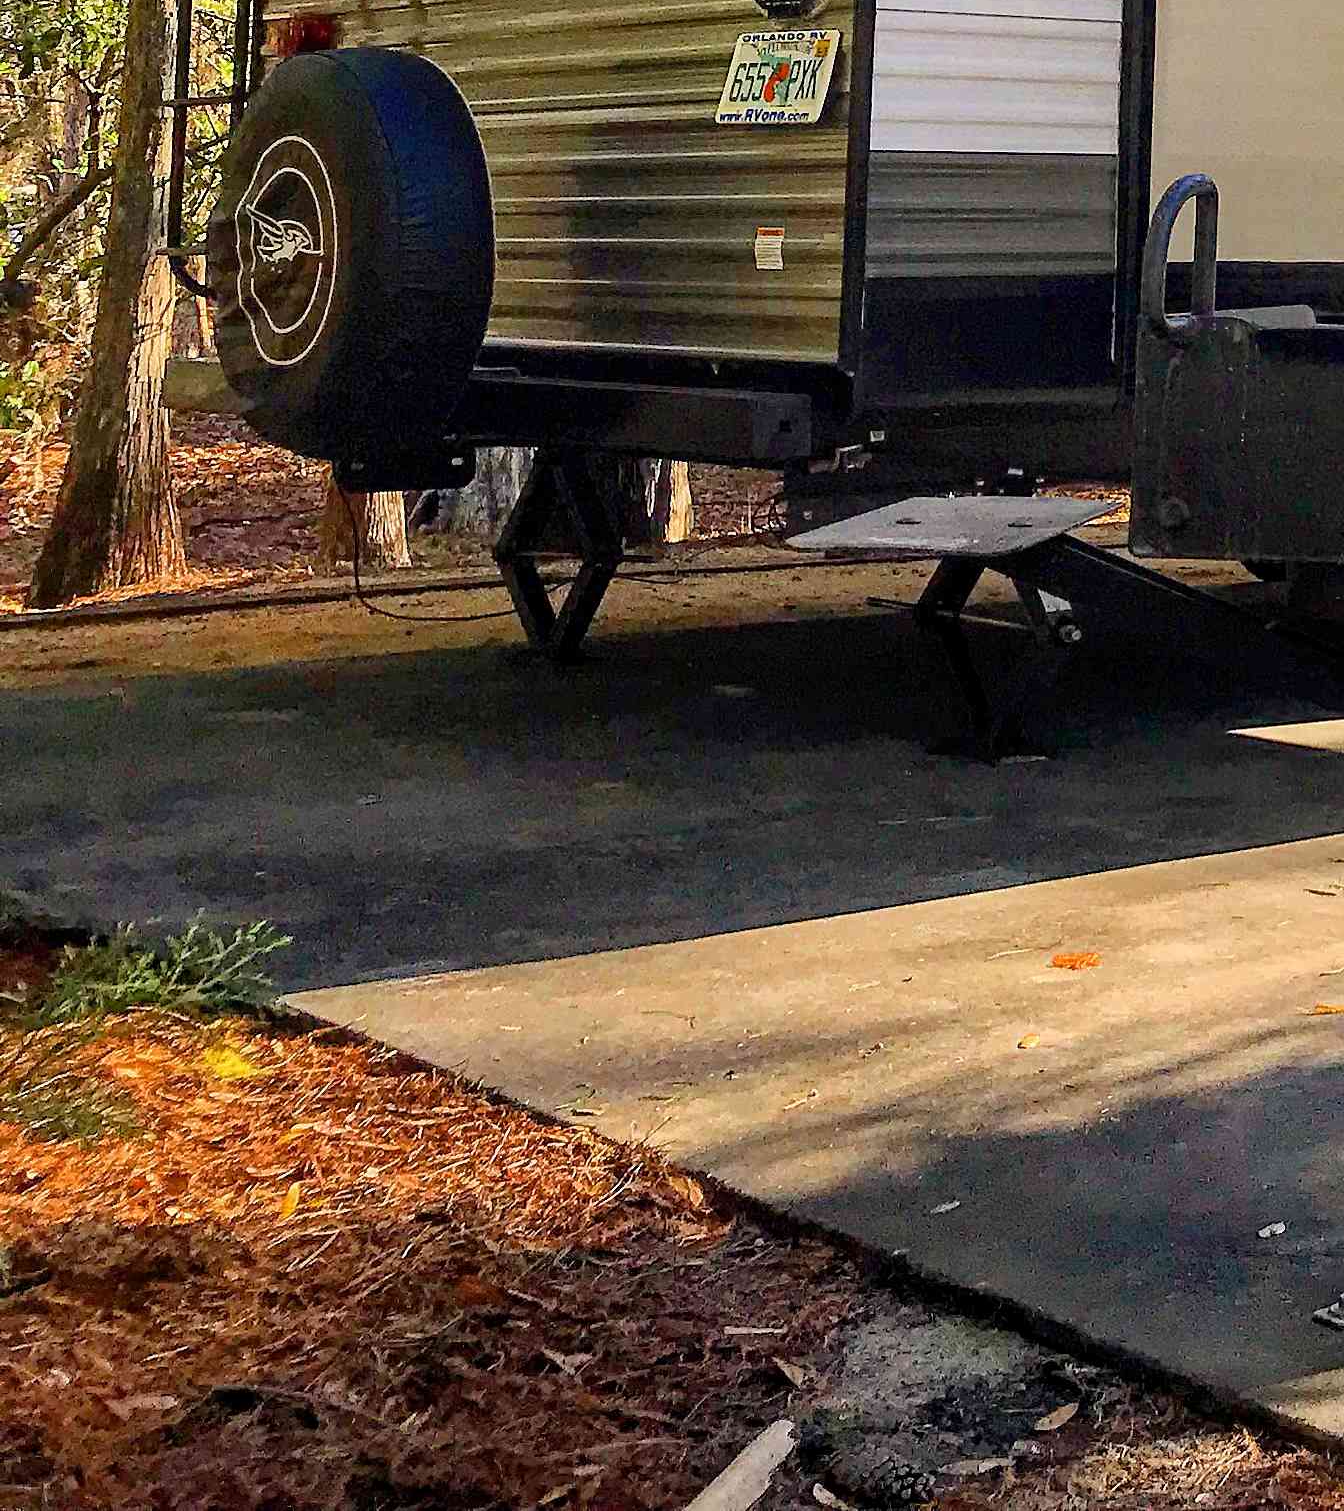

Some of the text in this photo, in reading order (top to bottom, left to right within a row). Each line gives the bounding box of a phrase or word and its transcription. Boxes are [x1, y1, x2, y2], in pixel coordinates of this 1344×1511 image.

[742, 31, 828, 42] ORLANDO RV
[729, 58, 824, 102] 655 PXK
